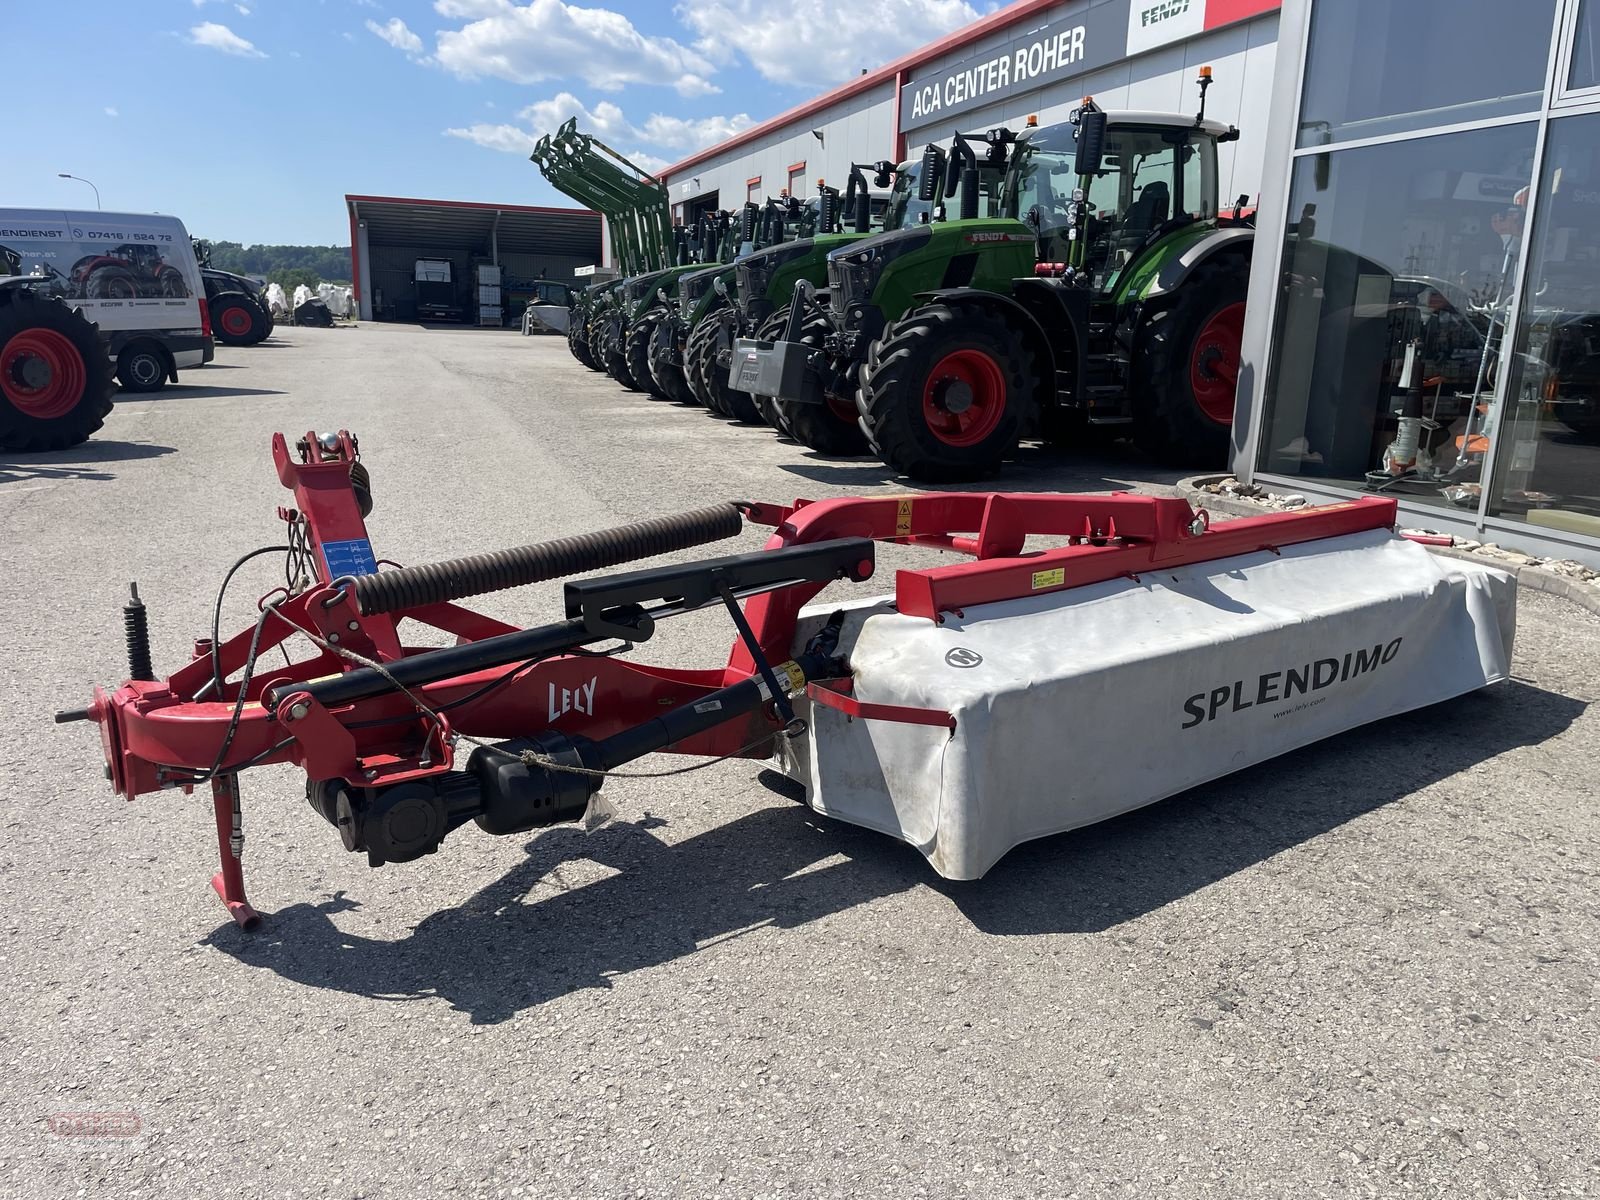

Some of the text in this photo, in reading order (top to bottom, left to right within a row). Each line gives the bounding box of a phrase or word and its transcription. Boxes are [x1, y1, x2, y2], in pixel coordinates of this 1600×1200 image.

[1141, 0, 1189, 27] FENDT
[912, 25, 1086, 119] ACA CENTER ROHER
[0, 229, 63, 238] ENDIENST
[133, 233, 155, 241] 524
[158, 234, 172, 242] 72
[972, 232, 1005, 241] FENDT
[1181, 637, 1403, 730] SPLENDIMO
[548, 676, 597, 723] LELY
[1272, 697, 1327, 720] www.lely.com
